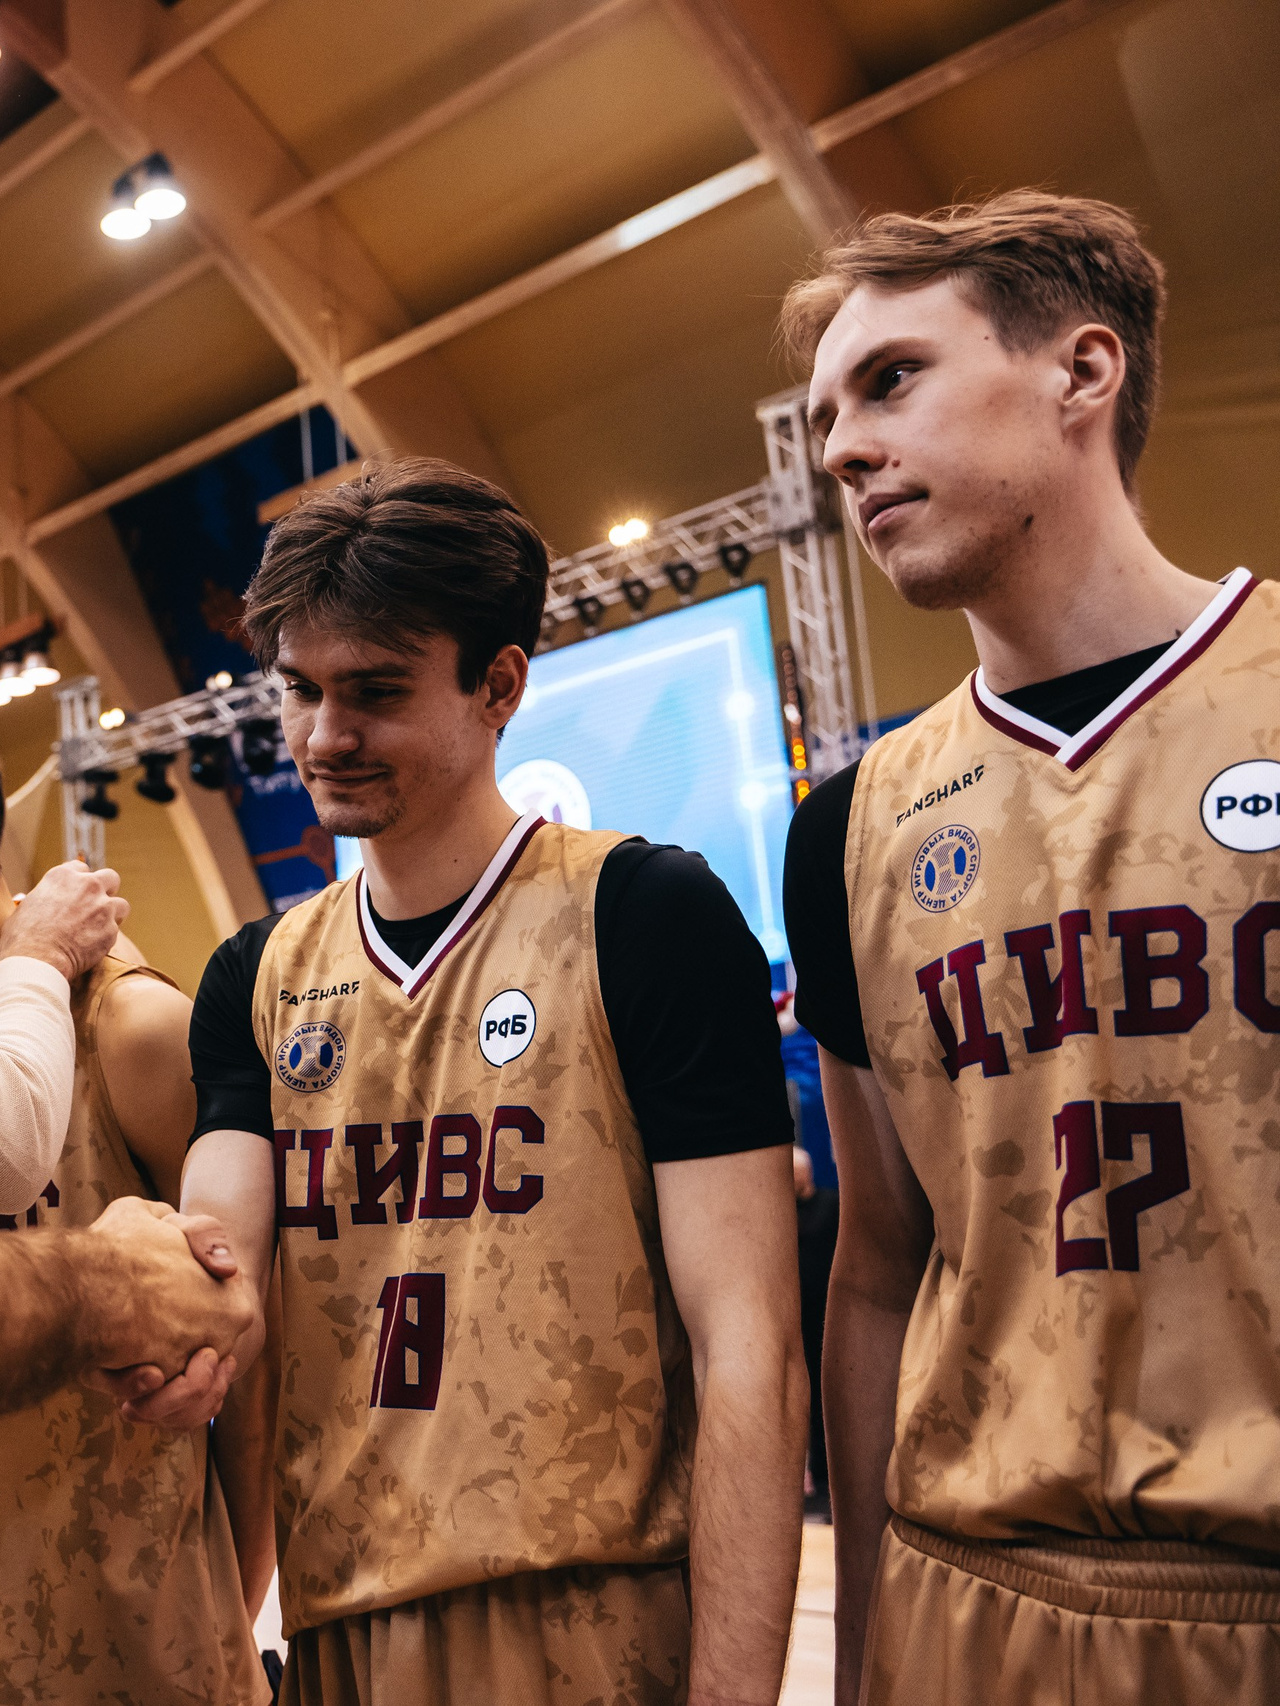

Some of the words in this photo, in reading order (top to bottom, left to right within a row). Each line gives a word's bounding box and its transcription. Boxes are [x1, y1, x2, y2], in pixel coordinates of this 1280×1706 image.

[1216, 792, 1280, 819] РФ
[947, 828, 976, 851] ВИДОВ
[914, 832, 945, 888] ИГРОВЫХ
[950, 854, 977, 902] СПОРТА
[917, 891, 946, 909] ЦЕНТР
[278, 1025, 318, 1061] ИГРОВЫХ
[319, 1024, 344, 1052] ВИДОВ
[485, 1014, 527, 1041] РФБ
[278, 1064, 307, 1089] ЦЕНТР
[312, 1055, 344, 1089] СПОРТА
[273, 1105, 546, 1241] ЦИВС
[1052, 1100, 1191, 1277] 27
[369, 1272, 446, 1411] 18
